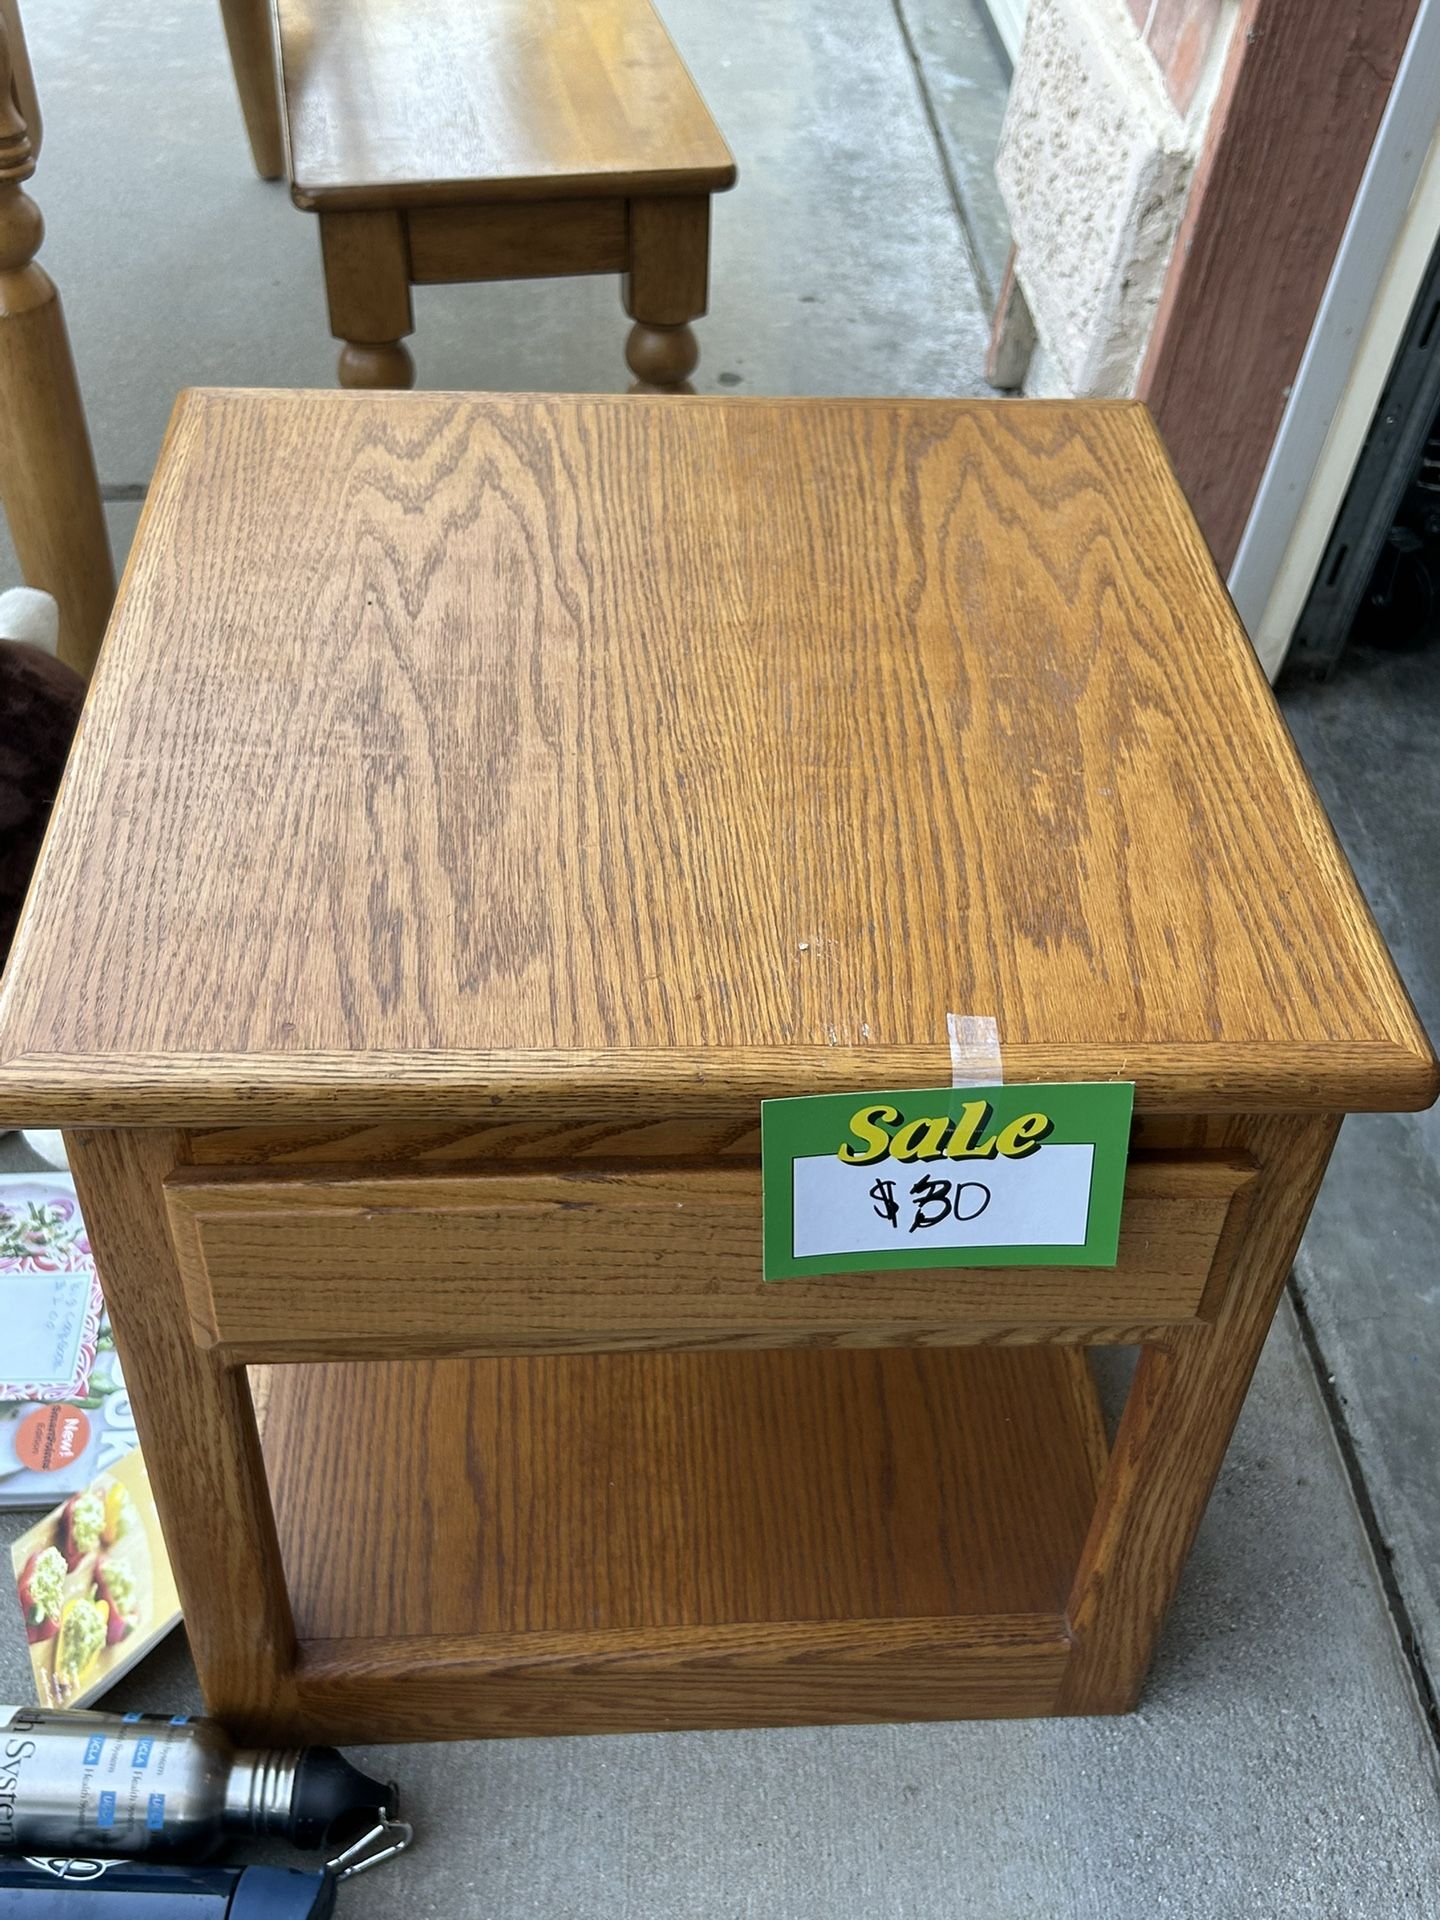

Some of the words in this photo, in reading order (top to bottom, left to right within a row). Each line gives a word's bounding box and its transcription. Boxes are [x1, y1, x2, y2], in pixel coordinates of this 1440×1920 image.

[59, 1418, 80, 1458] New!
[87, 1736, 102, 1762] UCLA
[135, 1739, 151, 1765] UCLA
[80, 1768, 95, 1799] Health
[129, 1770, 143, 1802] Health
